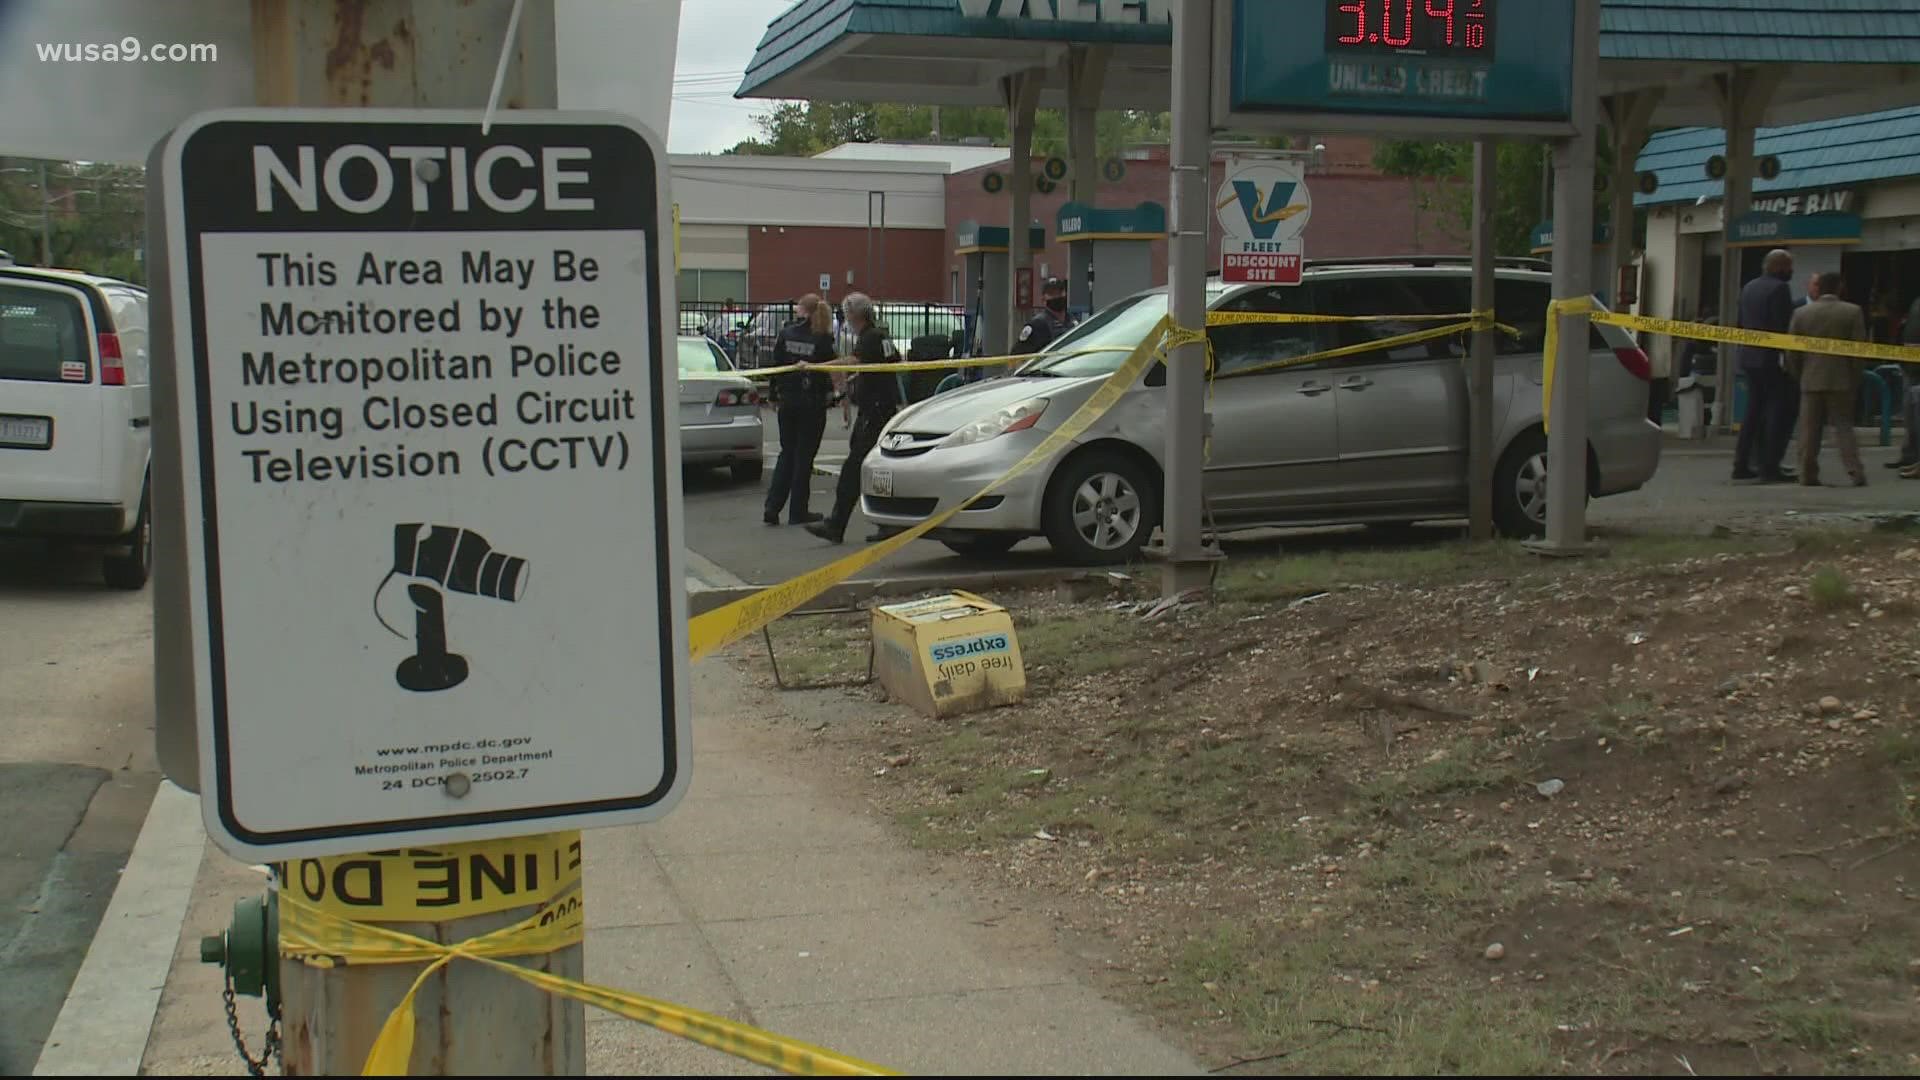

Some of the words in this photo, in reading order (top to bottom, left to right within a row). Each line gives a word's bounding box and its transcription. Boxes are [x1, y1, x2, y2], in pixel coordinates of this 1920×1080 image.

[253, 145, 594, 214] NOTICE
[1243, 242, 1282, 252] FLEET
[257, 252, 337, 287] This
[356, 251, 443, 286] Area
[461, 250, 535, 290] May
[553, 249, 600, 282] Be
[1227, 255, 1298, 268] DISCOUNT
[1247, 269, 1276, 281] SITE
[260, 300, 461, 337] Monitored
[479, 298, 523, 338] by
[542, 297, 600, 330] the
[242, 347, 492, 390] Metropolitan
[510, 344, 621, 378] Police
[231, 400, 343, 440] Using
[363, 393, 498, 430] Closed
[516, 388, 635, 425] Circuit
[241, 445, 460, 483] Television
[482, 431, 629, 477] (CCTV)
[934, 637, 1006, 660] express
[981, 656, 1014, 671] free
[377, 737, 532, 757] www.mpdc.dc.gov
[355, 761, 434, 775] Metropolitan
[440, 753, 476, 768] Police
[482, 750, 553, 765] Department
[382, 780, 403, 790] 24
[412, 776, 451, 788] DCM
[472, 768, 529, 783] 2502.7
